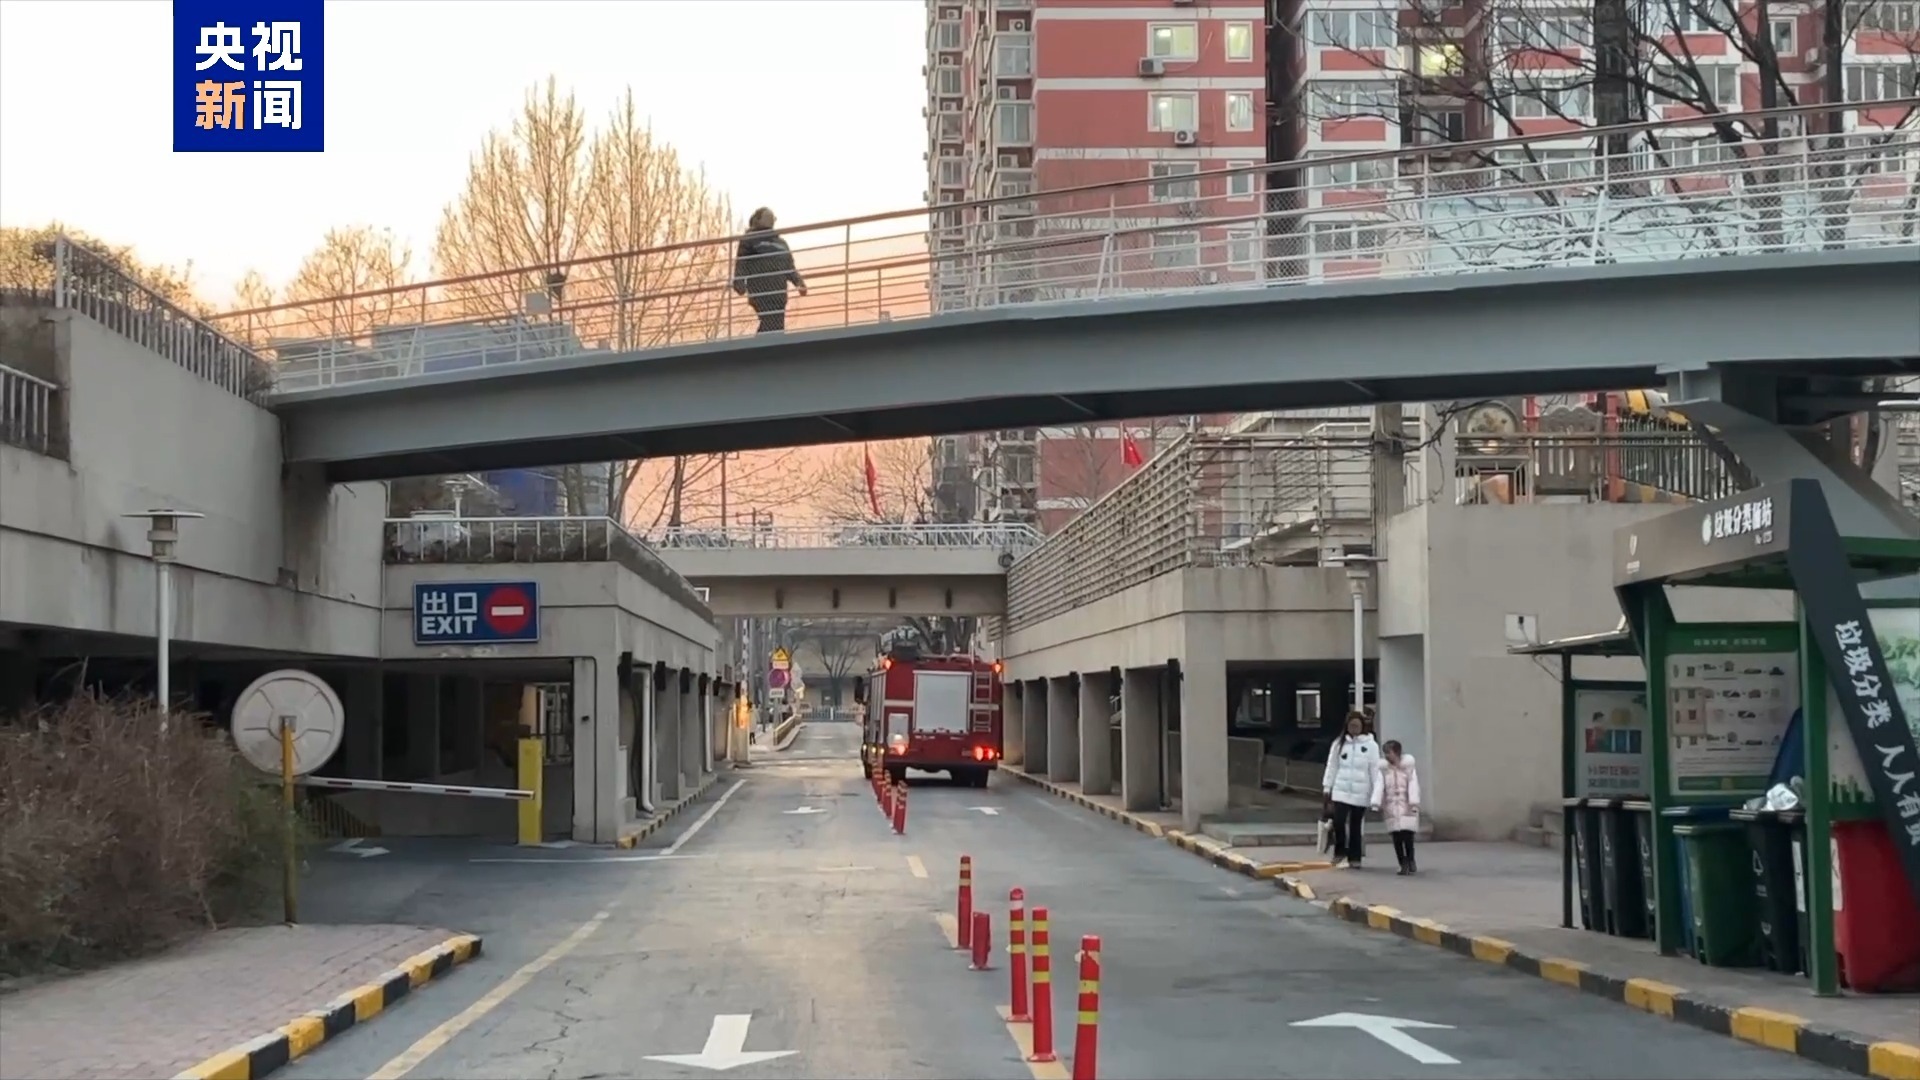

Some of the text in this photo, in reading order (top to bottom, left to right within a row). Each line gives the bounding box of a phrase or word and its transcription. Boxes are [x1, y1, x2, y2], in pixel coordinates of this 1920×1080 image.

[421, 590, 478, 615] 出口
[421, 615, 478, 635] EXIT
[1834, 620, 1893, 729] 垃圾分类
